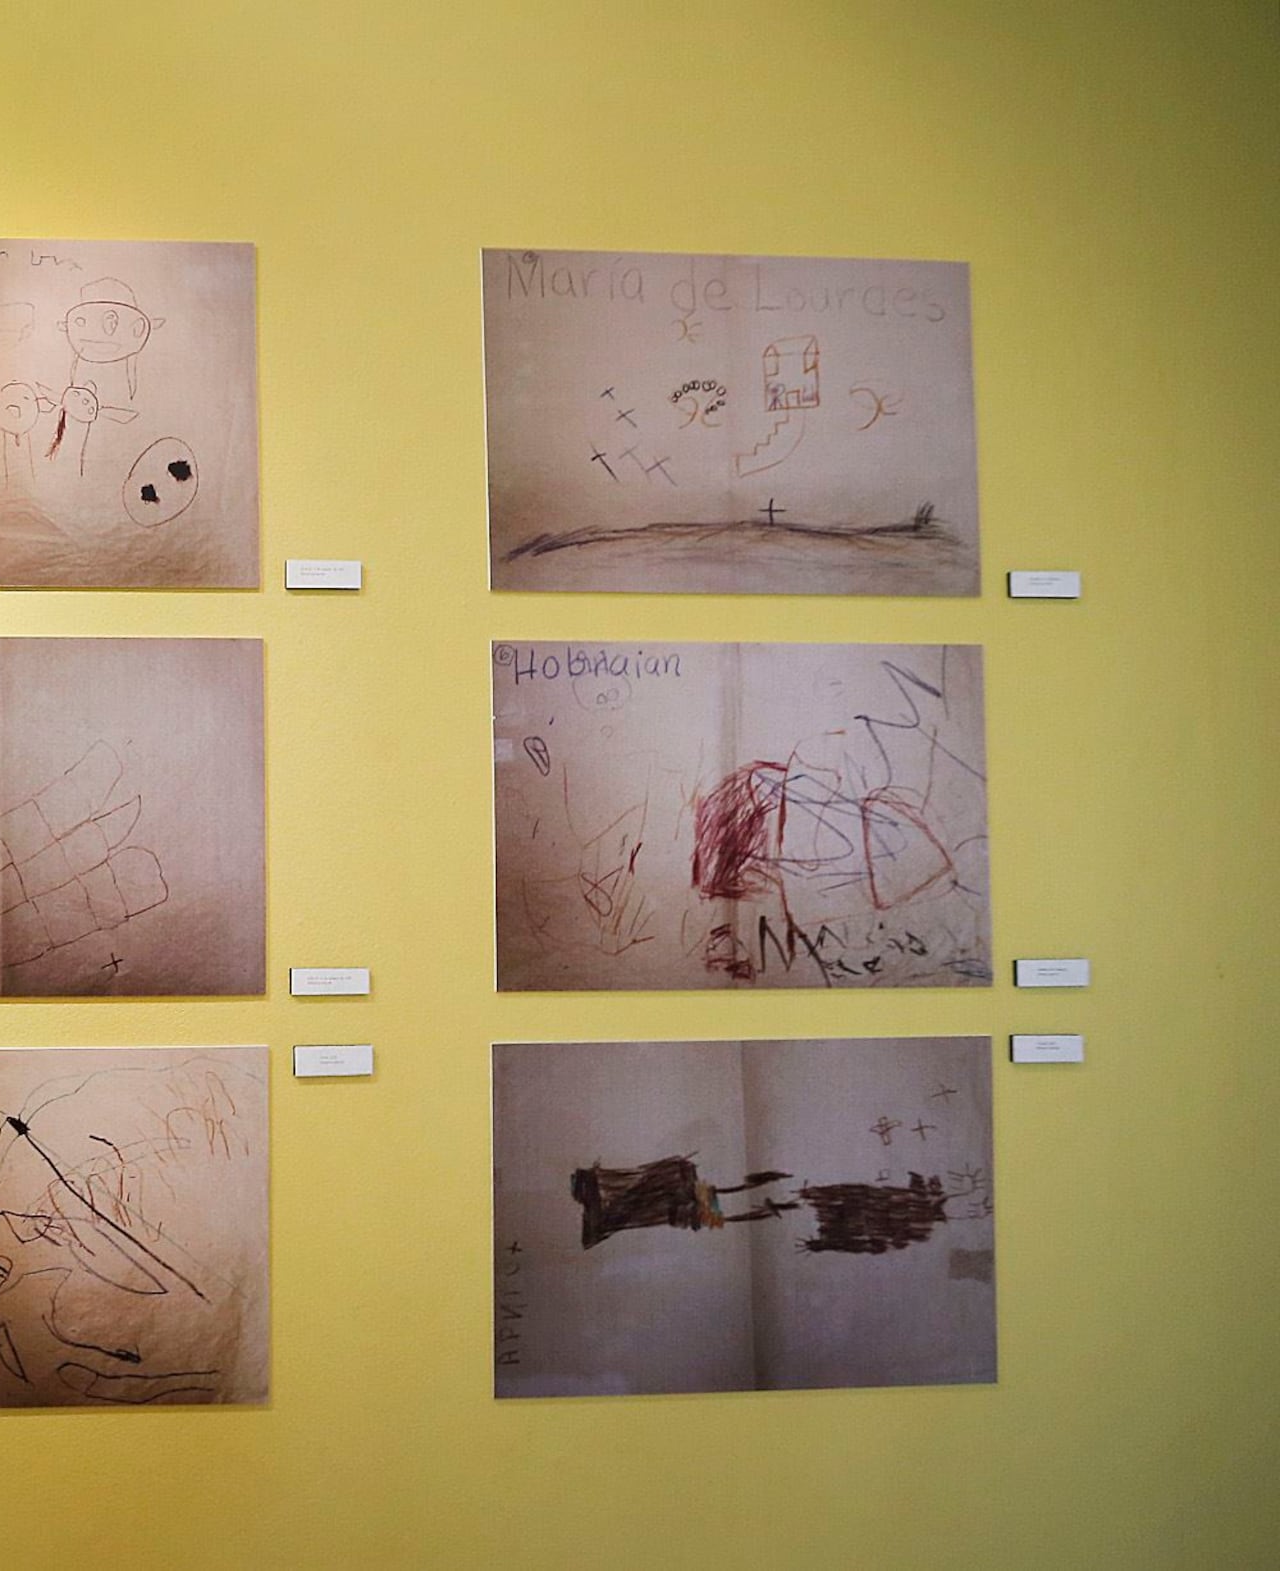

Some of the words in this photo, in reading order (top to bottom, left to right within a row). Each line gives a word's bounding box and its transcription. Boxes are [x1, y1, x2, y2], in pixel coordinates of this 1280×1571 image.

[507, 254, 644, 302] María
[670, 257, 733, 319] de
[755, 262, 946, 323] Lourdes
